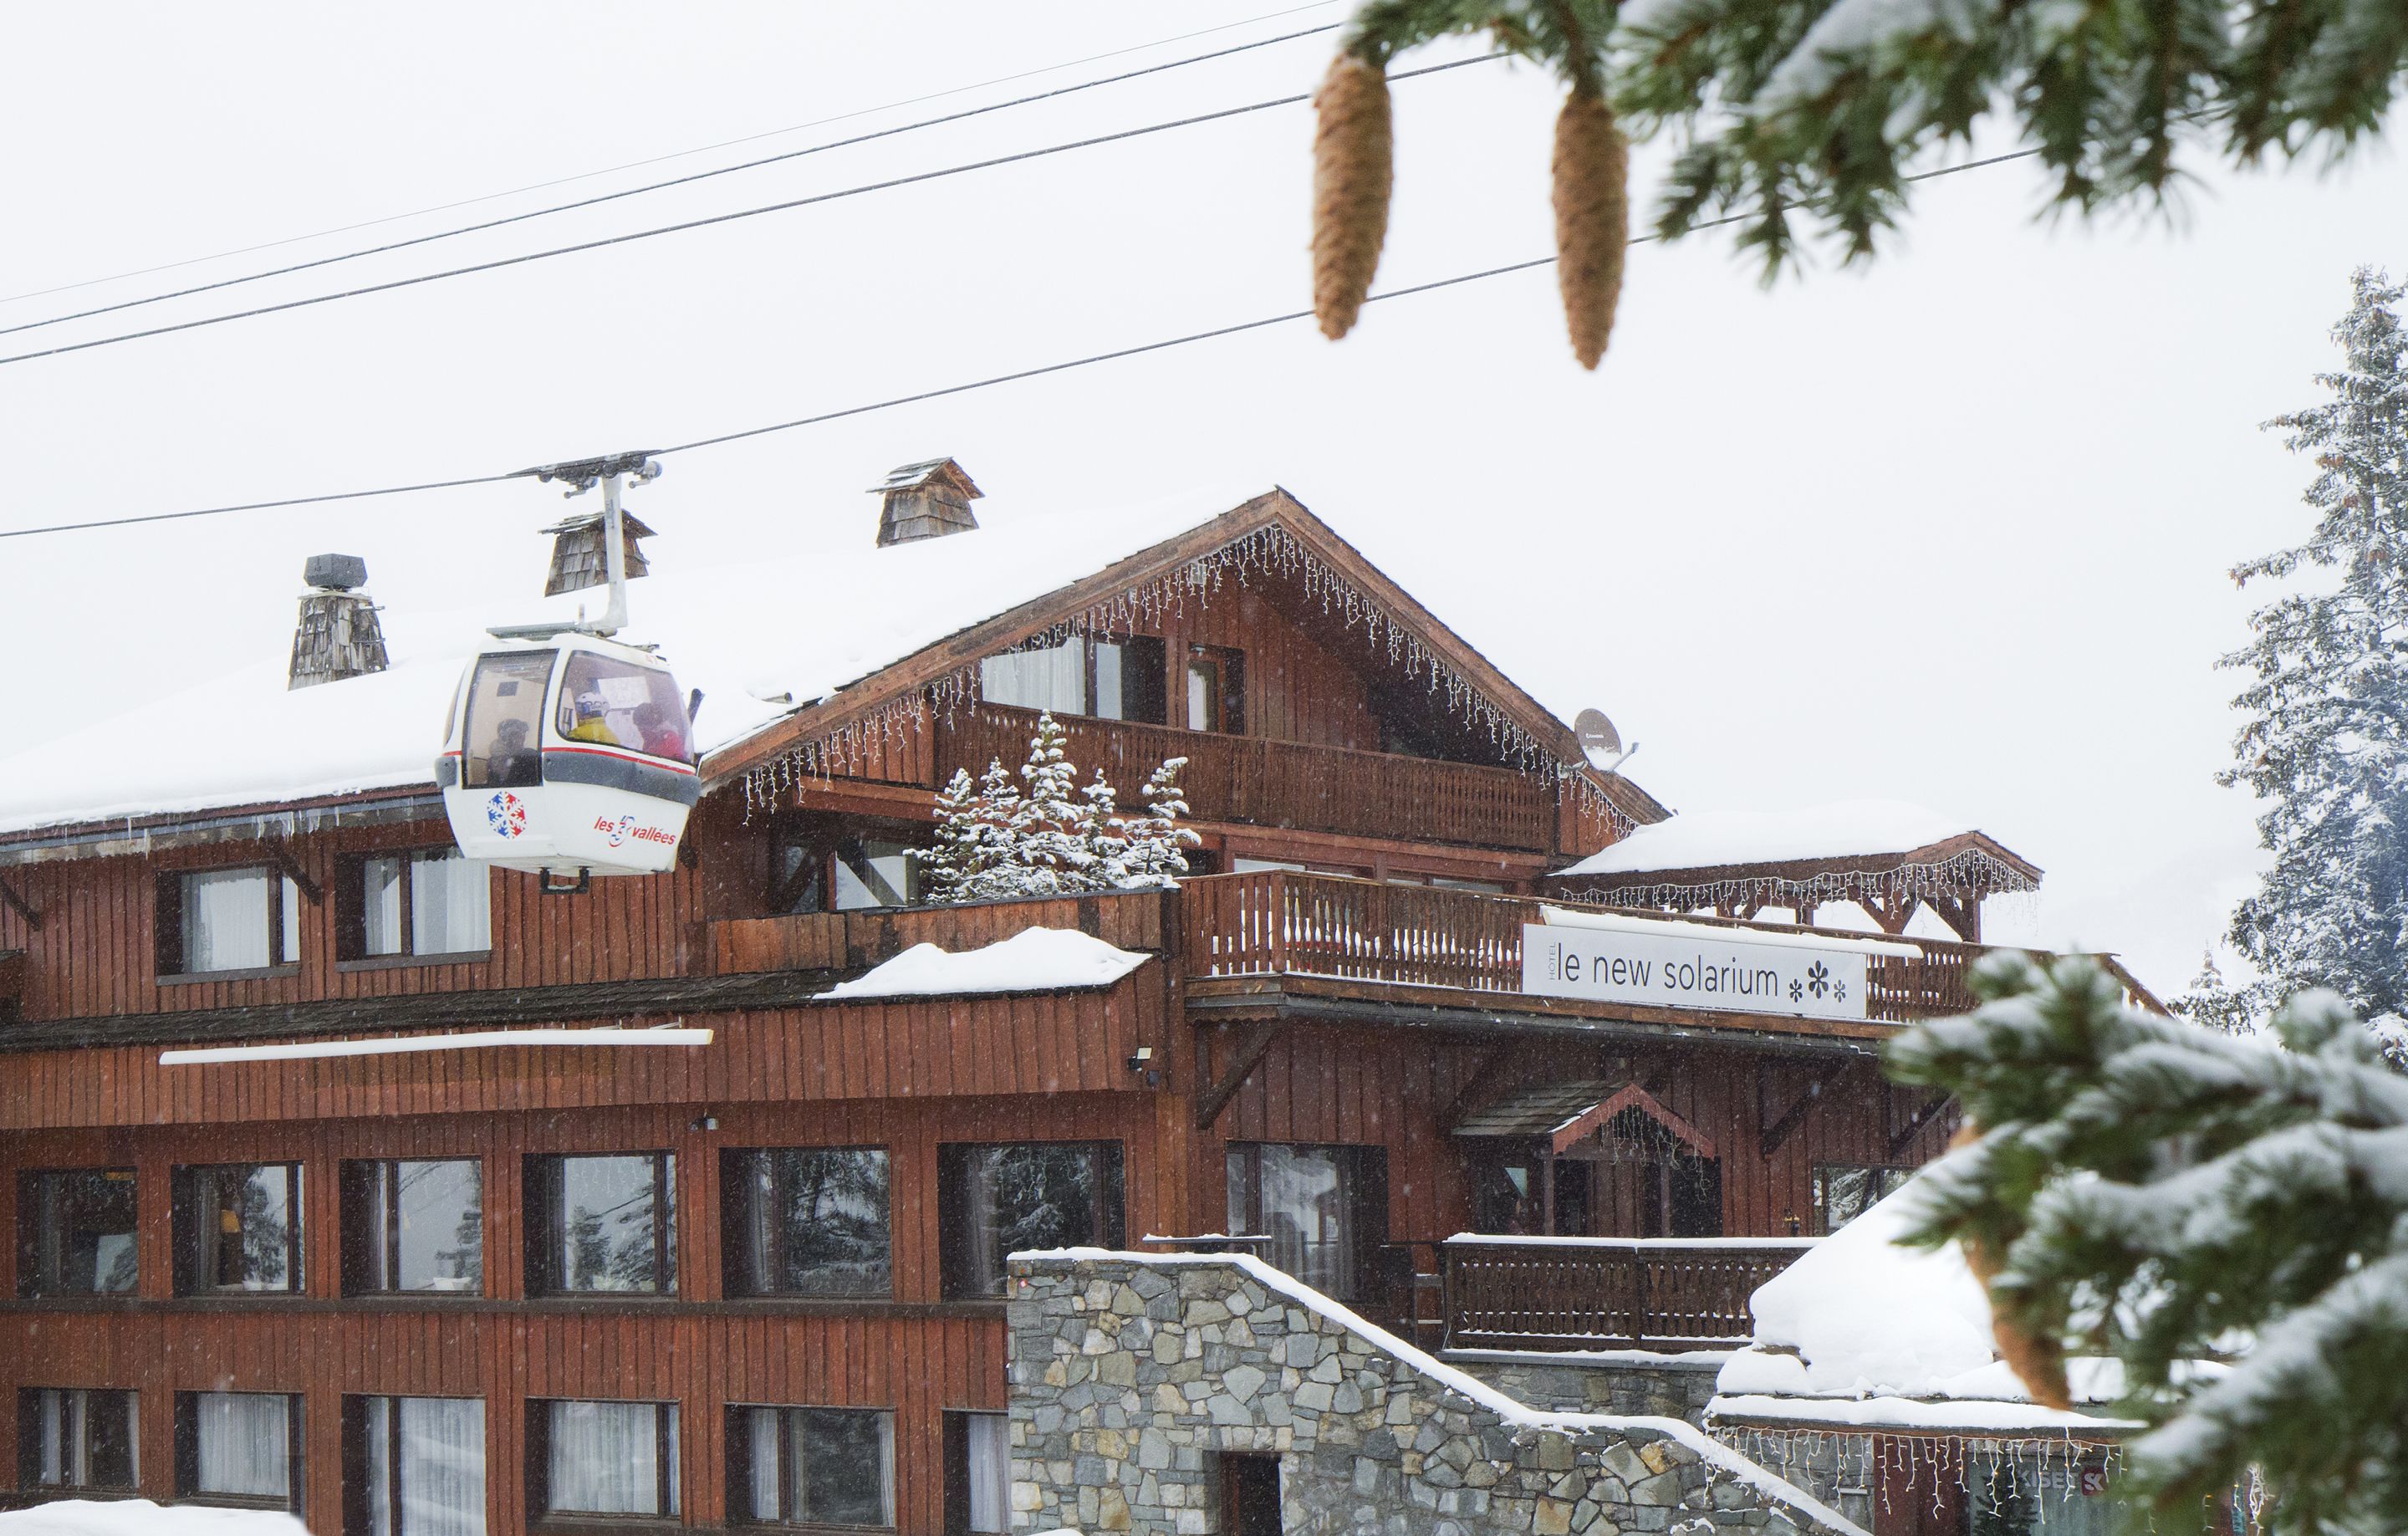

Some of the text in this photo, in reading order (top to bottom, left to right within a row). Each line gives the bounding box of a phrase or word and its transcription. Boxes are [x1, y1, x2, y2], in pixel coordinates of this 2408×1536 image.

[594, 816, 615, 833] les
[632, 826, 676, 845] vallées
[1558, 942, 1778, 997] le new solarium
